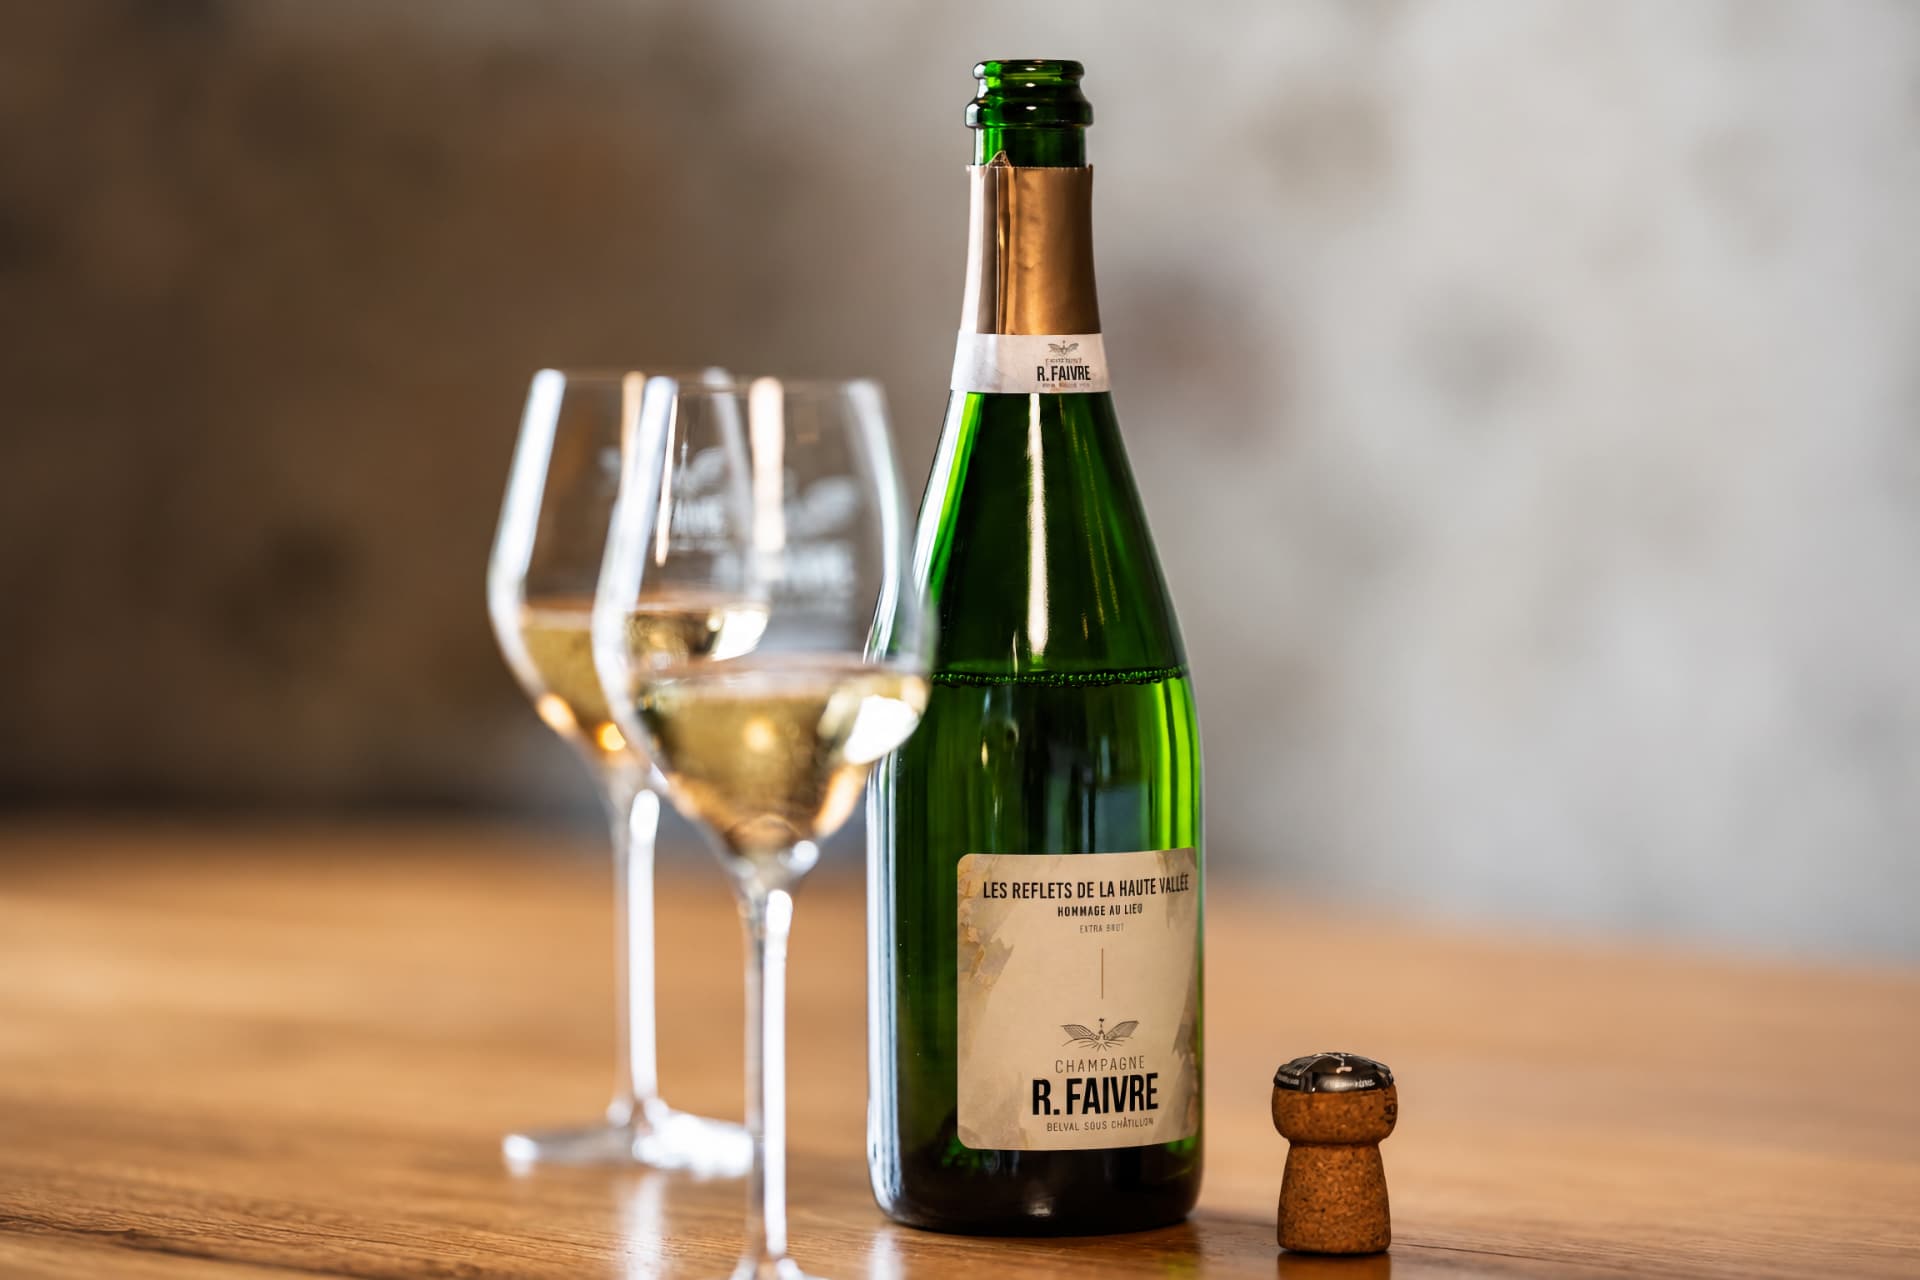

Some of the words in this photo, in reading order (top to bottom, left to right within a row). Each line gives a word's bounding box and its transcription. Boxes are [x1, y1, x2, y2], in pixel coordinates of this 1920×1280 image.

[1051, 365, 1091, 381] FAIVRE
[983, 881, 1007, 899] LES
[1012, 881, 1072, 899] REFLETS
[1077, 881, 1094, 898] DE
[1100, 880, 1115, 898] LA
[1120, 878, 1156, 897] HAUTE
[1159, 872, 1189, 893] VALLÉE
[1057, 905, 1106, 917] HOMMAGE
[1109, 905, 1121, 916] AU
[1124, 903, 1143, 915] LIEU
[1079, 924, 1103, 934] EXTRA
[1106, 923, 1124, 933] BRUT
[1055, 1055, 1145, 1074] CHAMPAGNE
[1066, 1072, 1159, 1115] FAIVRE
[1047, 1122, 1080, 1132] BELVAL
[1084, 1120, 1107, 1131] SOUS
[1111, 1116, 1154, 1129] CHÂTILLON
